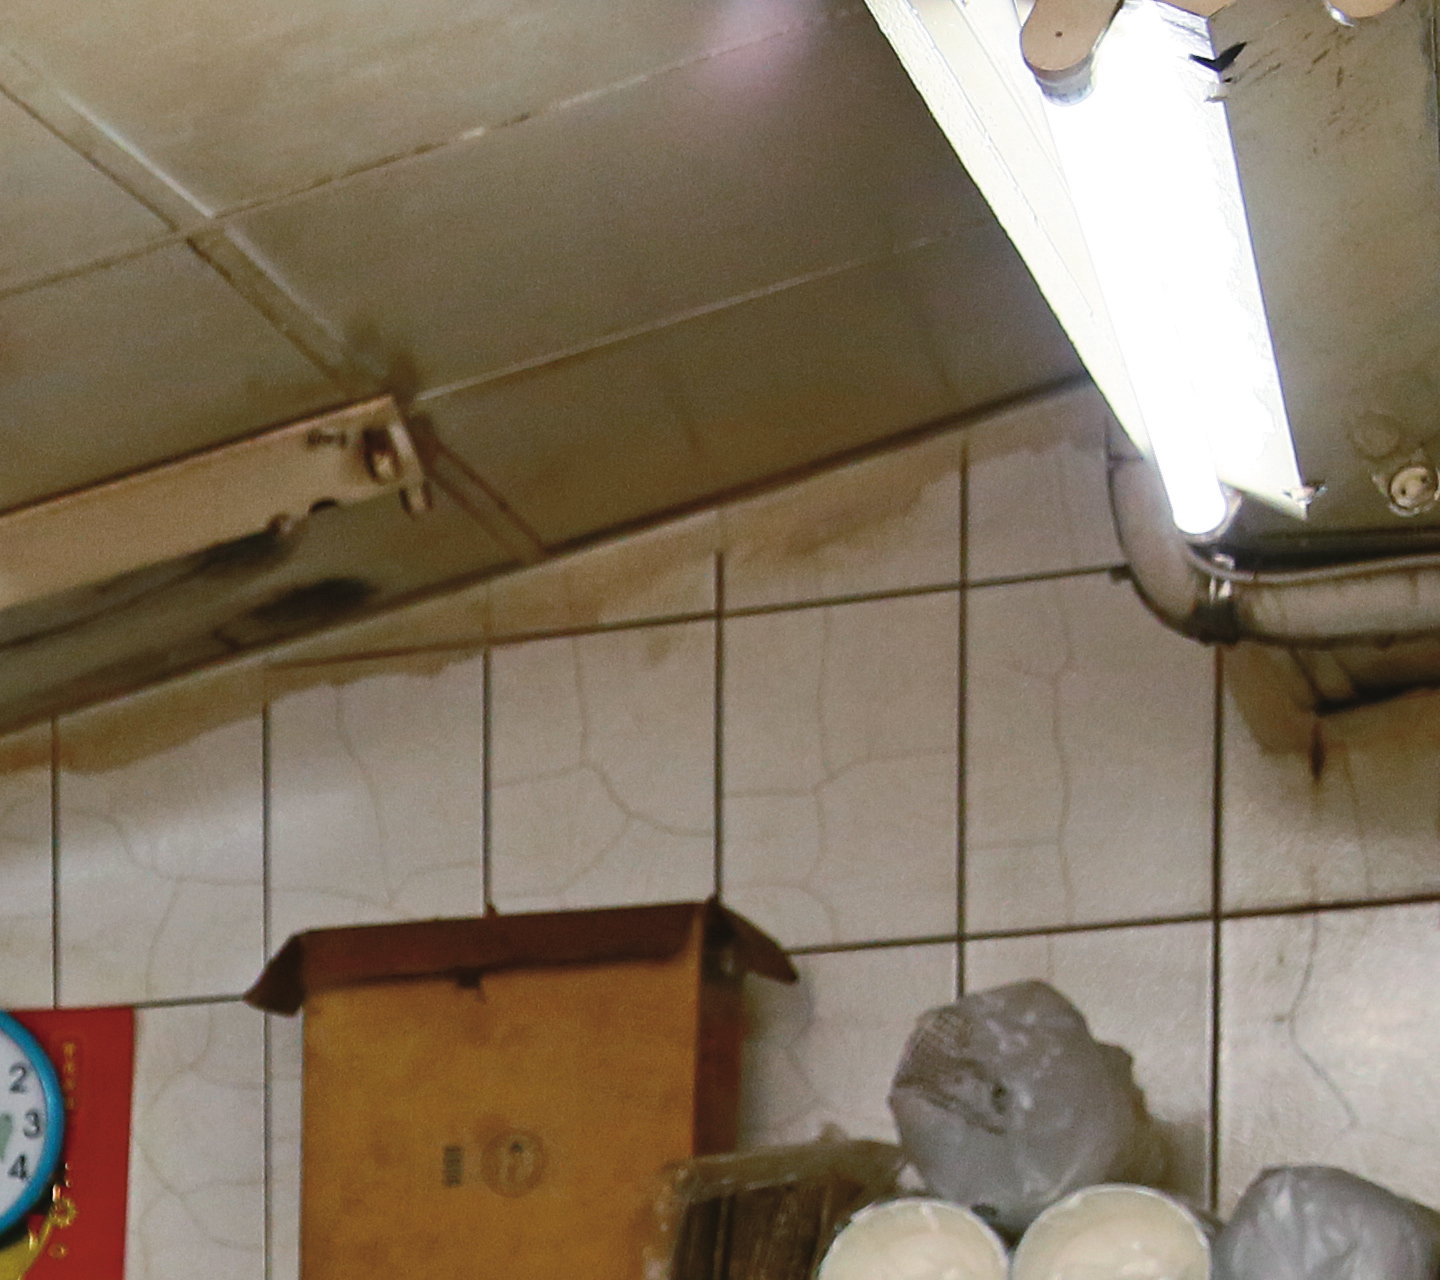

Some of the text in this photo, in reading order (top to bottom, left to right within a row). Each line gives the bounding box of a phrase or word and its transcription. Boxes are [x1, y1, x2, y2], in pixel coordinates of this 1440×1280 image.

[9, 1064, 28, 1092] 2
[23, 1112, 41, 1138] 3
[8, 1155, 28, 1180] 4
